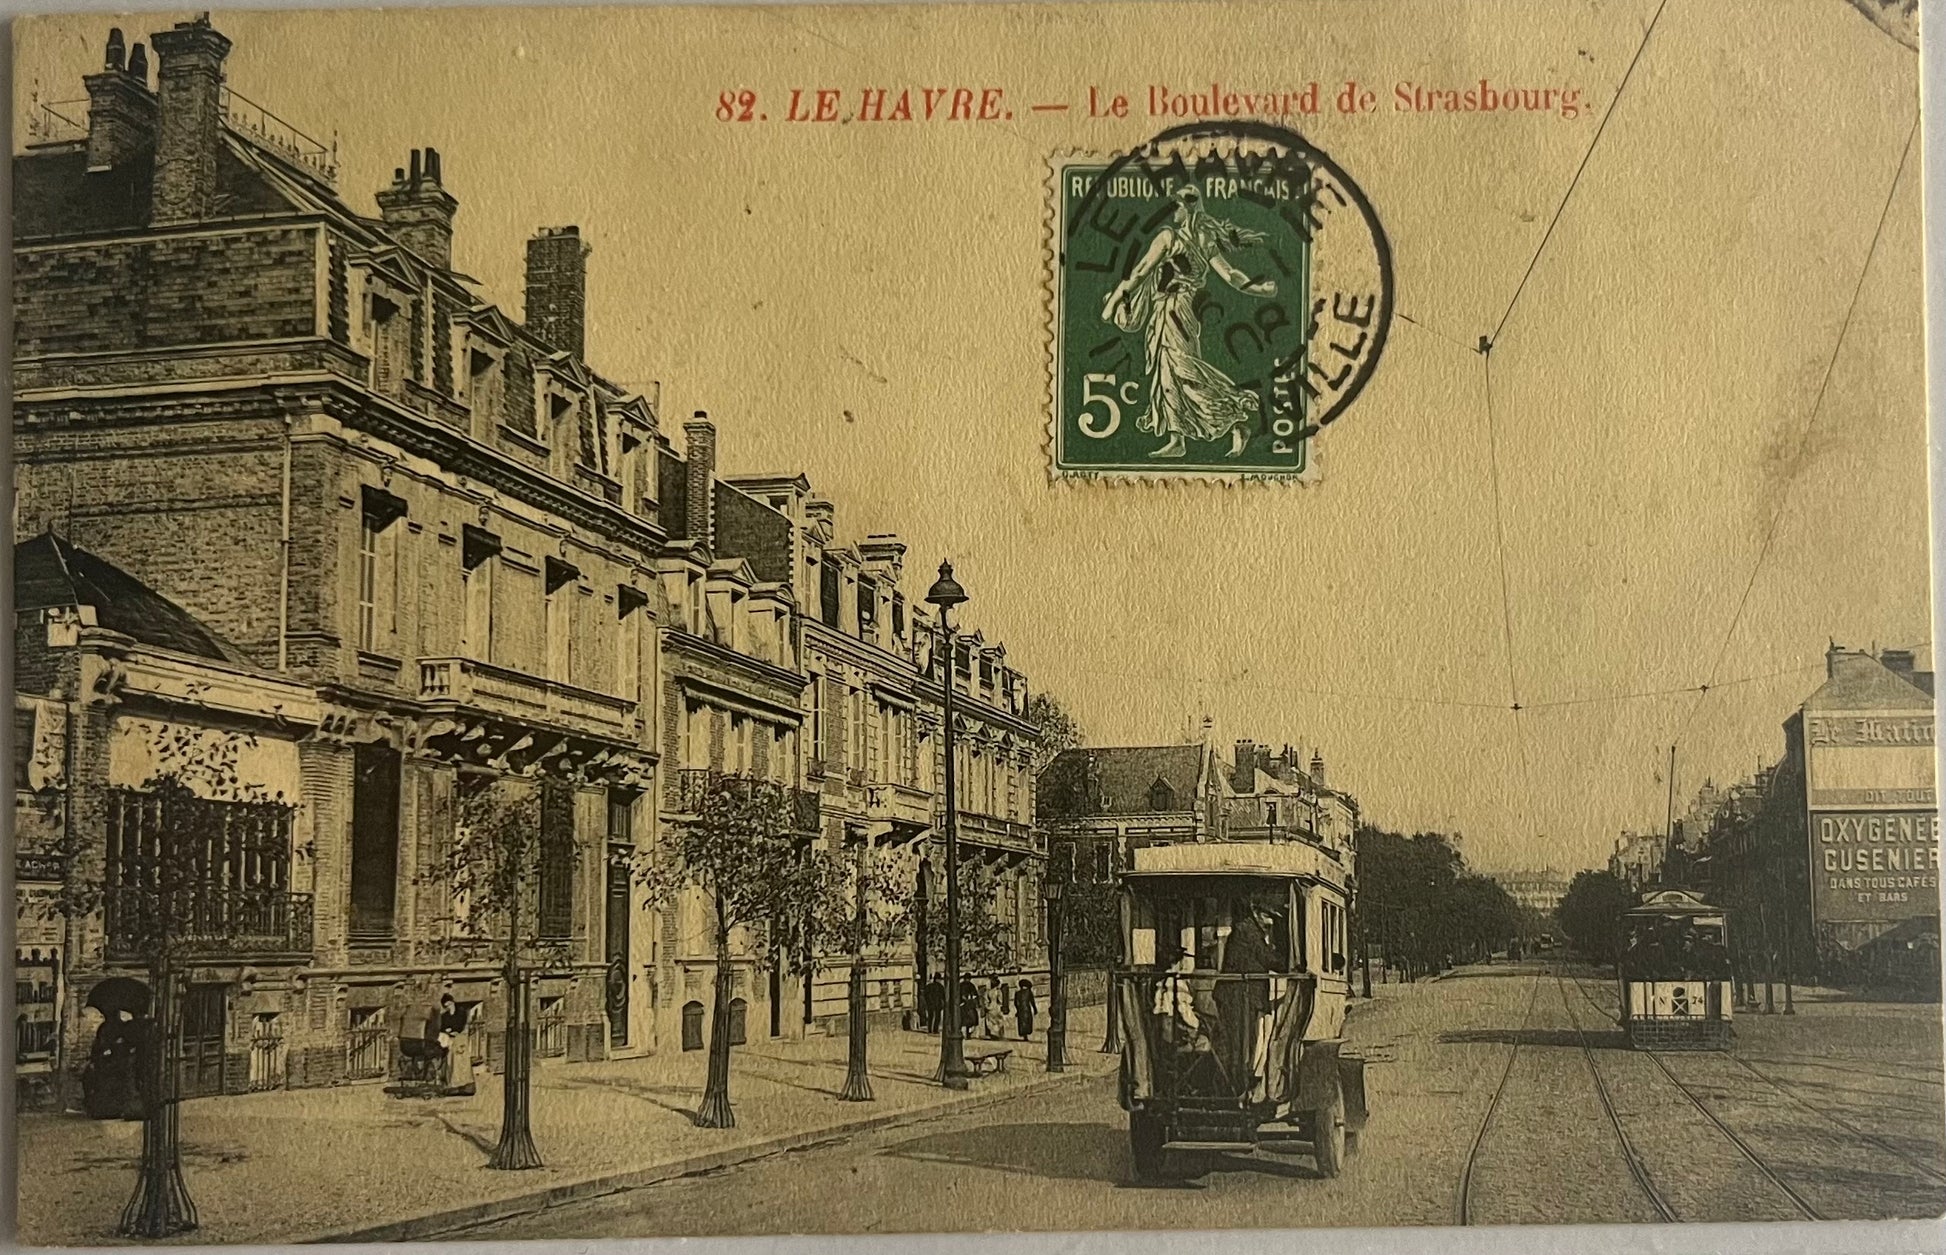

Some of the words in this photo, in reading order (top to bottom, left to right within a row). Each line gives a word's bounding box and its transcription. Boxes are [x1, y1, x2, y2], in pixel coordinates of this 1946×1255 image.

[1830, 877, 1861, 889] DANS
[1864, 876, 1896, 889] TOUS
[1858, 892, 1872, 903] ET
[1878, 892, 1909, 903] BARS
